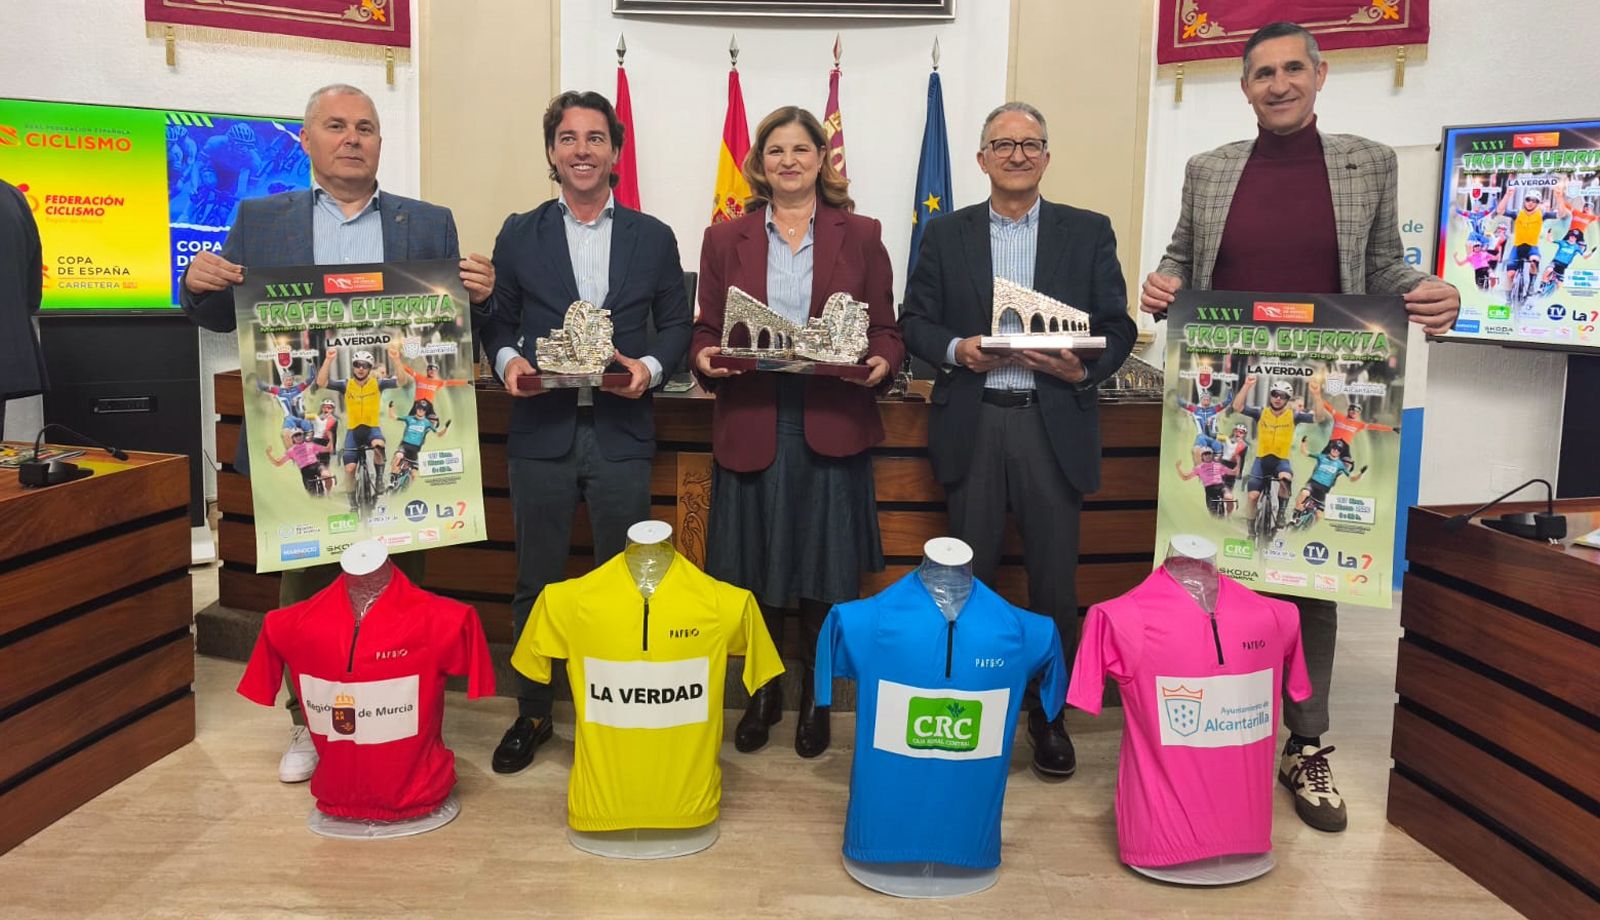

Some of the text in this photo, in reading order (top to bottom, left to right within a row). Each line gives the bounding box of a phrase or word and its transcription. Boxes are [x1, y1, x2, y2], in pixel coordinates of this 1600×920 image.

[26, 131, 132, 152] CICLISMO
[1472, 139, 1506, 151] XXXV
[1463, 152, 1525, 168] TROFEO
[1508, 178, 1558, 187] LA VERDAD
[45, 194, 125, 206] FEDERACIÓN
[45, 205, 105, 216] CICLISMO
[1402, 219, 1424, 233] de
[176, 240, 223, 252] COPA
[57, 255, 93, 265] COPA
[57, 265, 130, 275] DE ESPAÑA
[58, 280, 120, 289] CARRETERA
[265, 282, 314, 298] XXXV
[256, 294, 457, 325] TROFEO GUERRITA
[1196, 307, 1244, 321] XXXV
[1550, 306, 1565, 316] TV
[326, 335, 391, 347] LA VERDAD
[1186, 324, 1389, 356] TROFEO GUERRITA
[1247, 365, 1314, 376] LA VERDAD
[408, 503, 425, 516] TV
[1225, 544, 1250, 555] CRC
[1306, 545, 1326, 558] TV
[590, 683, 703, 705] LA VERDAD
[358, 708, 372, 718] de
[375, 703, 414, 717] Murcia
[914, 715, 973, 740] CRC
[1204, 711, 1270, 732] Alcantarilla
